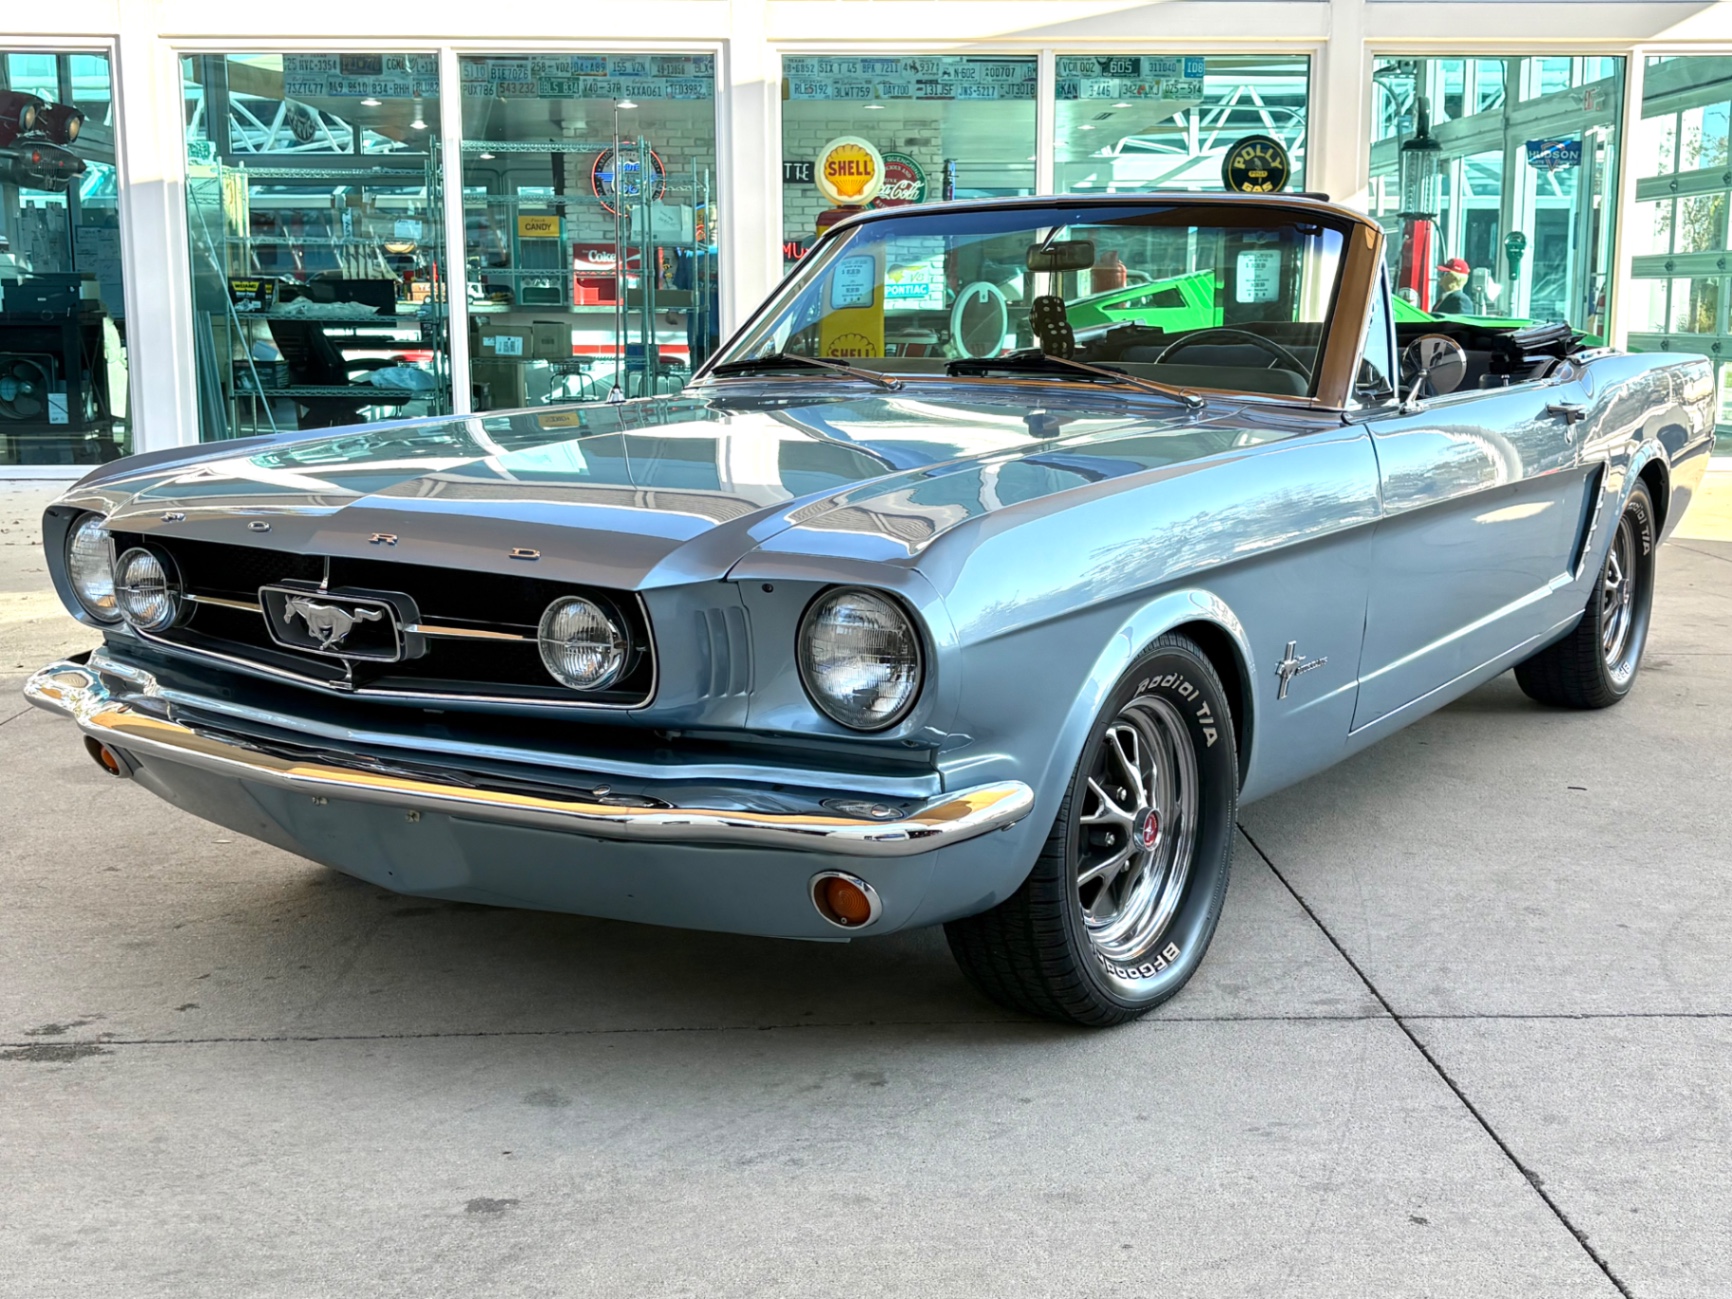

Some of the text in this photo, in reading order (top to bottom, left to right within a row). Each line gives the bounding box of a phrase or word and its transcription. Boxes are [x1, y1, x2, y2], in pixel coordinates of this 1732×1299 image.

[499, 82, 516, 94] 543
[1233, 144, 1283, 169] POLLY
[827, 160, 872, 176] SHELL
[1241, 181, 1273, 192] GAS
[524, 222, 552, 231] CANDY
[886, 284, 928, 294] PONTIAC
